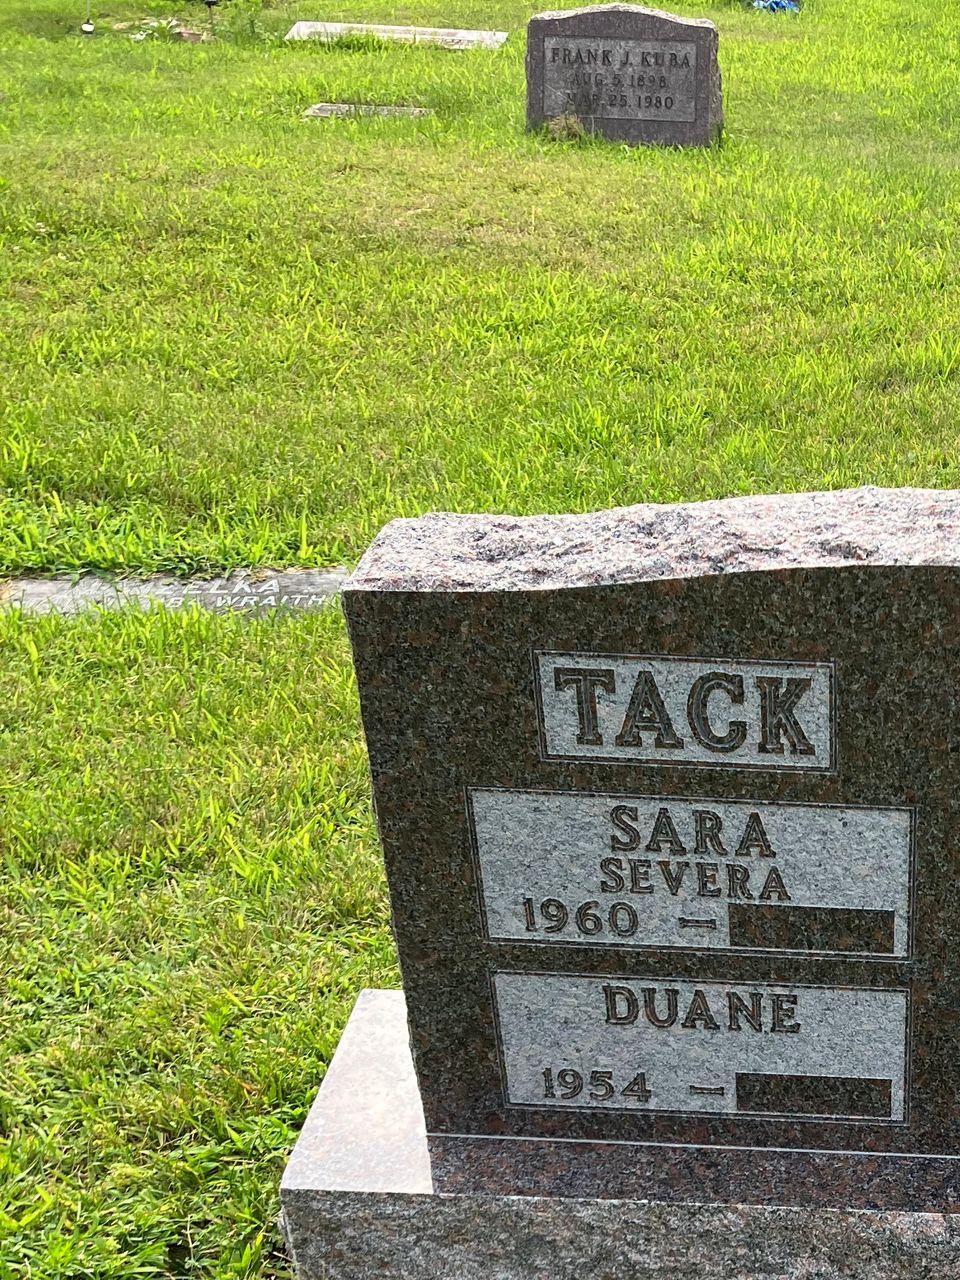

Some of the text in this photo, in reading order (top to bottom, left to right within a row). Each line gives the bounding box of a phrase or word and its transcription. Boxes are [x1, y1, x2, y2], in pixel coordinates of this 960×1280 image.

[551, 48, 612, 66] FRANK
[641, 51, 690, 69] KUBA
[629, 74, 666, 88] 1898
[637, 95, 674, 110] 1980
[216, 594, 327, 608] WRAITH
[553, 666, 816, 756] TACK
[610, 805, 778, 859] SARA
[600, 857, 792, 900] SEVERA
[522, 898, 639, 937] 1960
[602, 984, 802, 1034] DUANE
[541, 1067, 652, 1102] 1954
